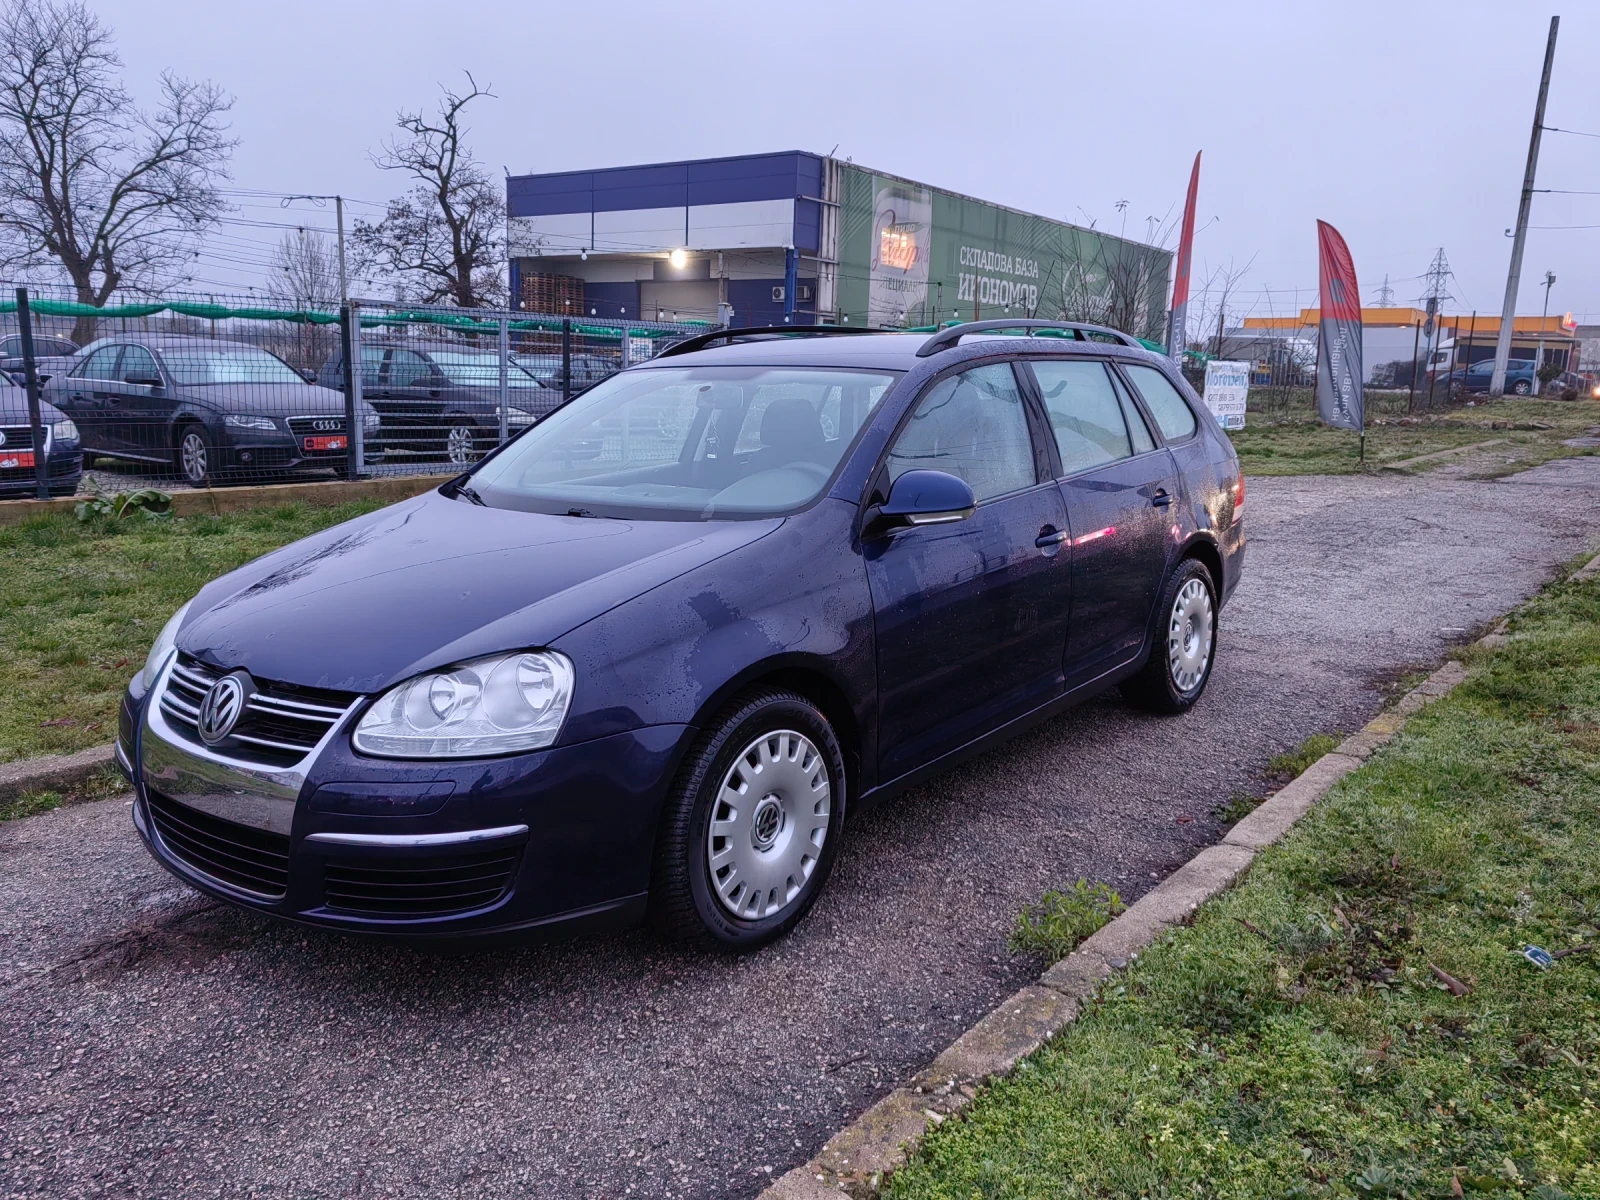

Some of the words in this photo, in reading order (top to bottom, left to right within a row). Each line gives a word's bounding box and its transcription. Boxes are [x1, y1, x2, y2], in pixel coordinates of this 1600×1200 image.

[960, 246, 1013, 273] СКЛАДОВА
[1015, 257, 1039, 278] БАЗА
[957, 272, 1038, 310] ИКОНОМОВ
